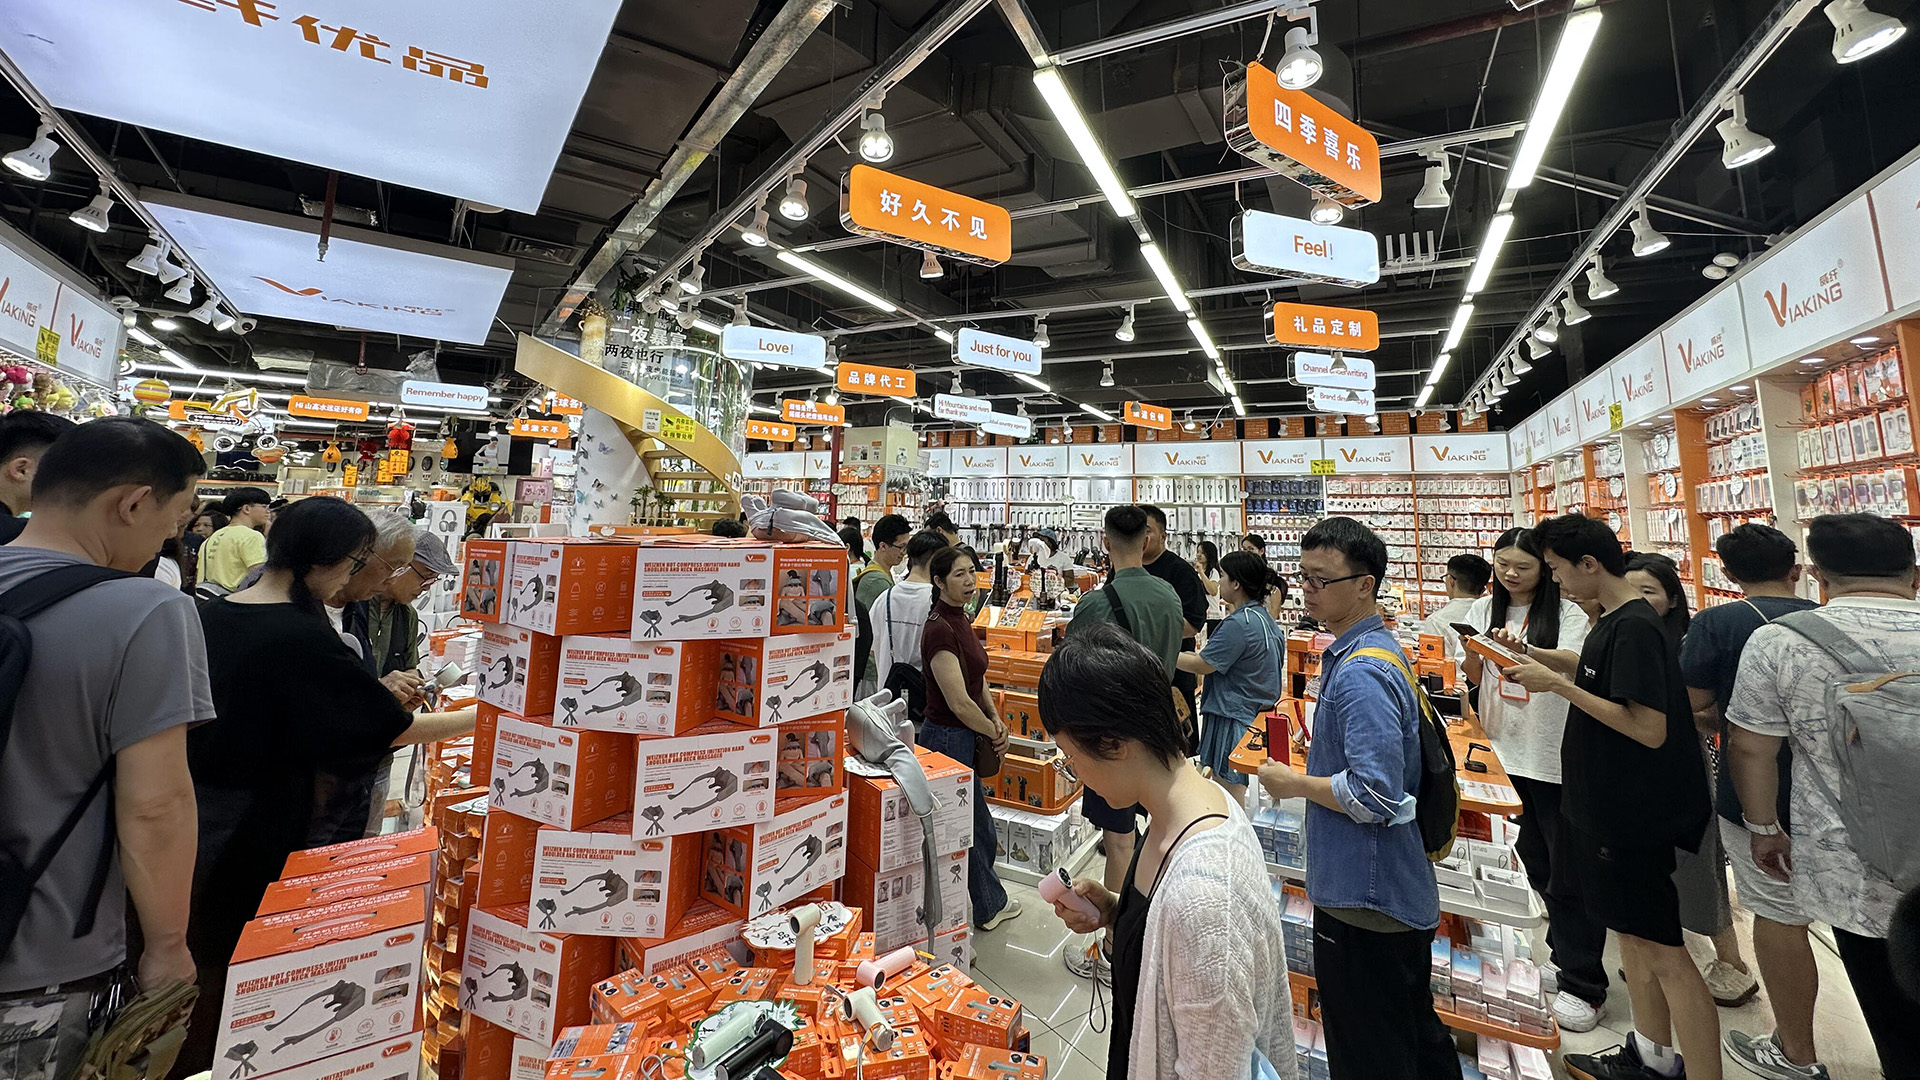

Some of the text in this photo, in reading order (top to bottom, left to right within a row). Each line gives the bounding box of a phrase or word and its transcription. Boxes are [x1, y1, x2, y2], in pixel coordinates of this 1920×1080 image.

[1274, 98, 1362, 171] 四季喜乐
[880, 189, 988, 241] 好久不见
[1293, 235, 1334, 260] Feel!
[610, 324, 687, 348] 一夜暴富
[1293, 316, 1361, 337] 礼品定制
[604, 344, 664, 365] 两夜也行
[758, 338, 794, 355] Love!
[970, 340, 1032, 363] Just for you
[1303, 363, 1328, 374] Channel
[849, 371, 906, 389] 品牌代工
[406, 388, 484, 403] Remember happy
[945, 401, 968, 410] Mountains
[1320, 392, 1336, 401] Brand
[270, 972, 285, 983] HOT
[286, 963, 324, 979] COMPRESS
[325, 955, 359, 970] IMITATION
[359, 950, 378, 961] HAND
[235, 964, 347, 996] SHOULDER AND NECK MASSAGER
[356, 1061, 374, 1073] HAND
